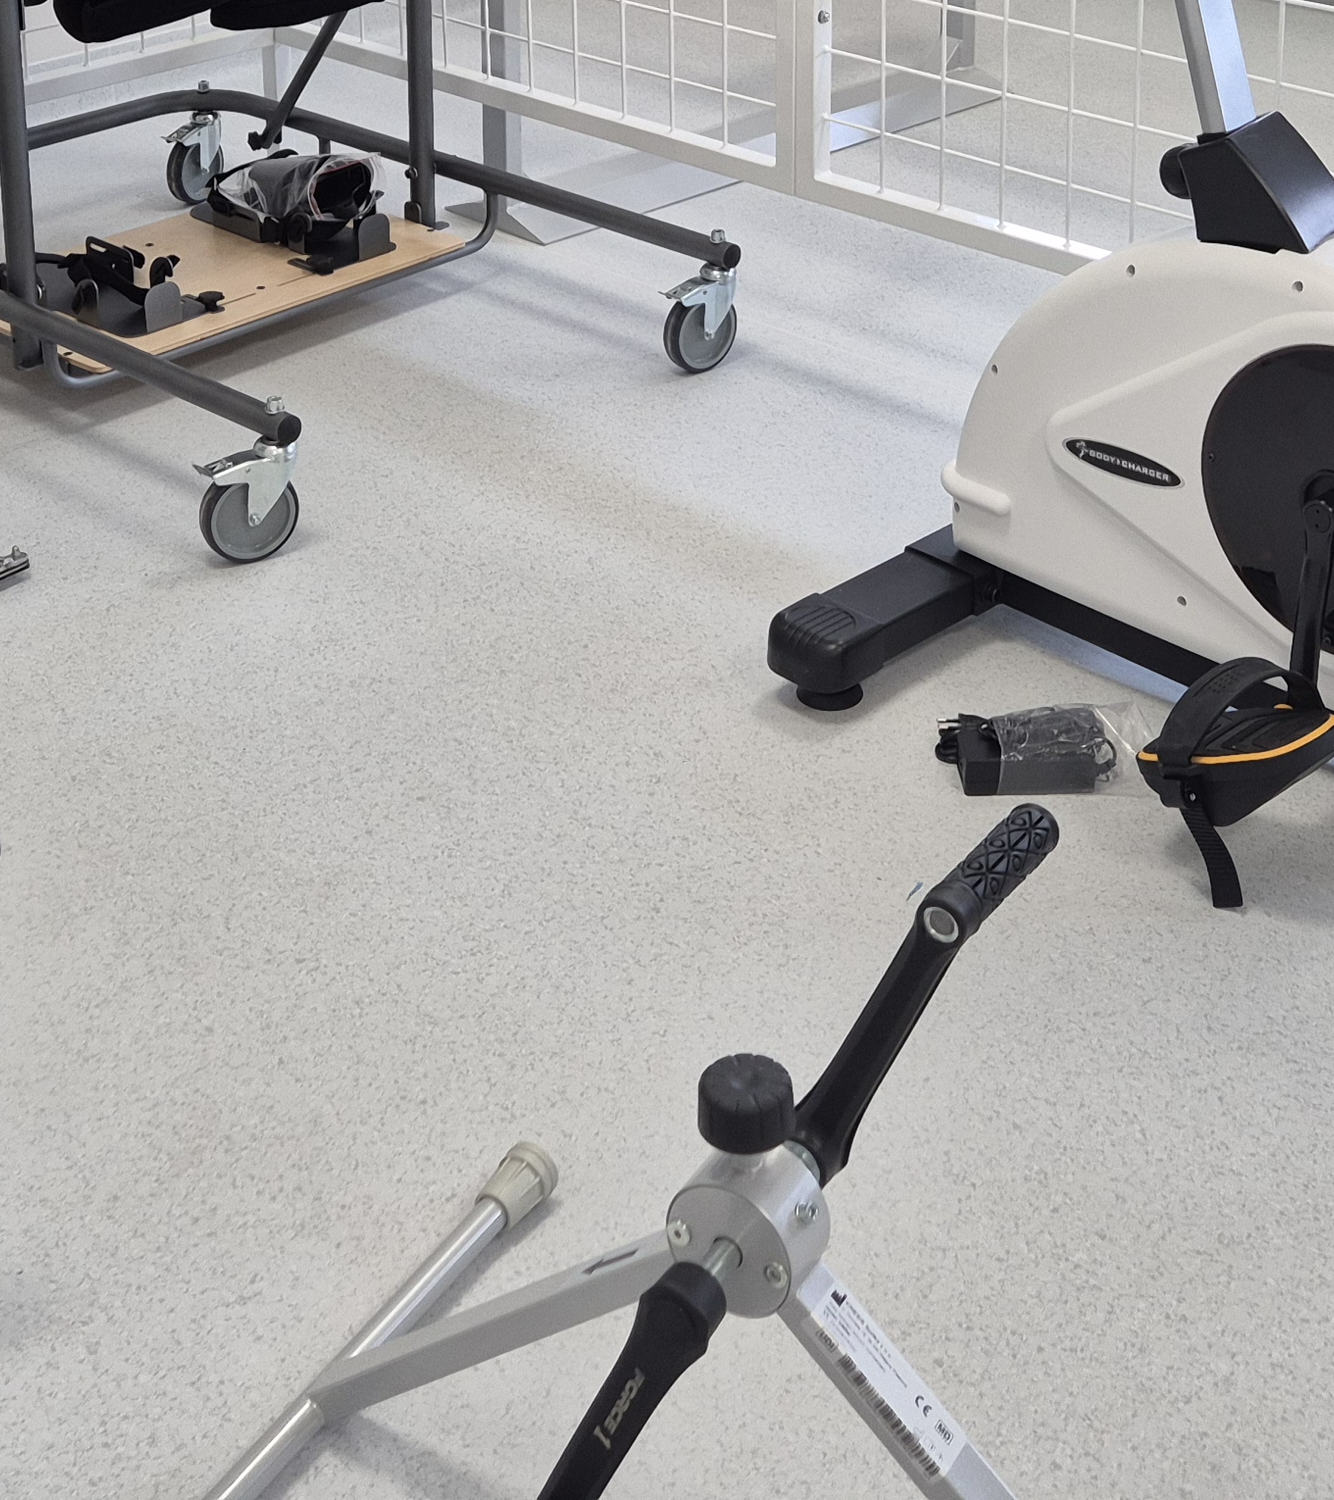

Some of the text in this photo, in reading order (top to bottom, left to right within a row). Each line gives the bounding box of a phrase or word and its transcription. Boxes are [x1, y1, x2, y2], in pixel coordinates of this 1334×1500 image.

[1089, 449, 1170, 483] BODY CHARGER
[603, 1366, 646, 1437] FORCE
[936, 1422, 952, 1443] MD
